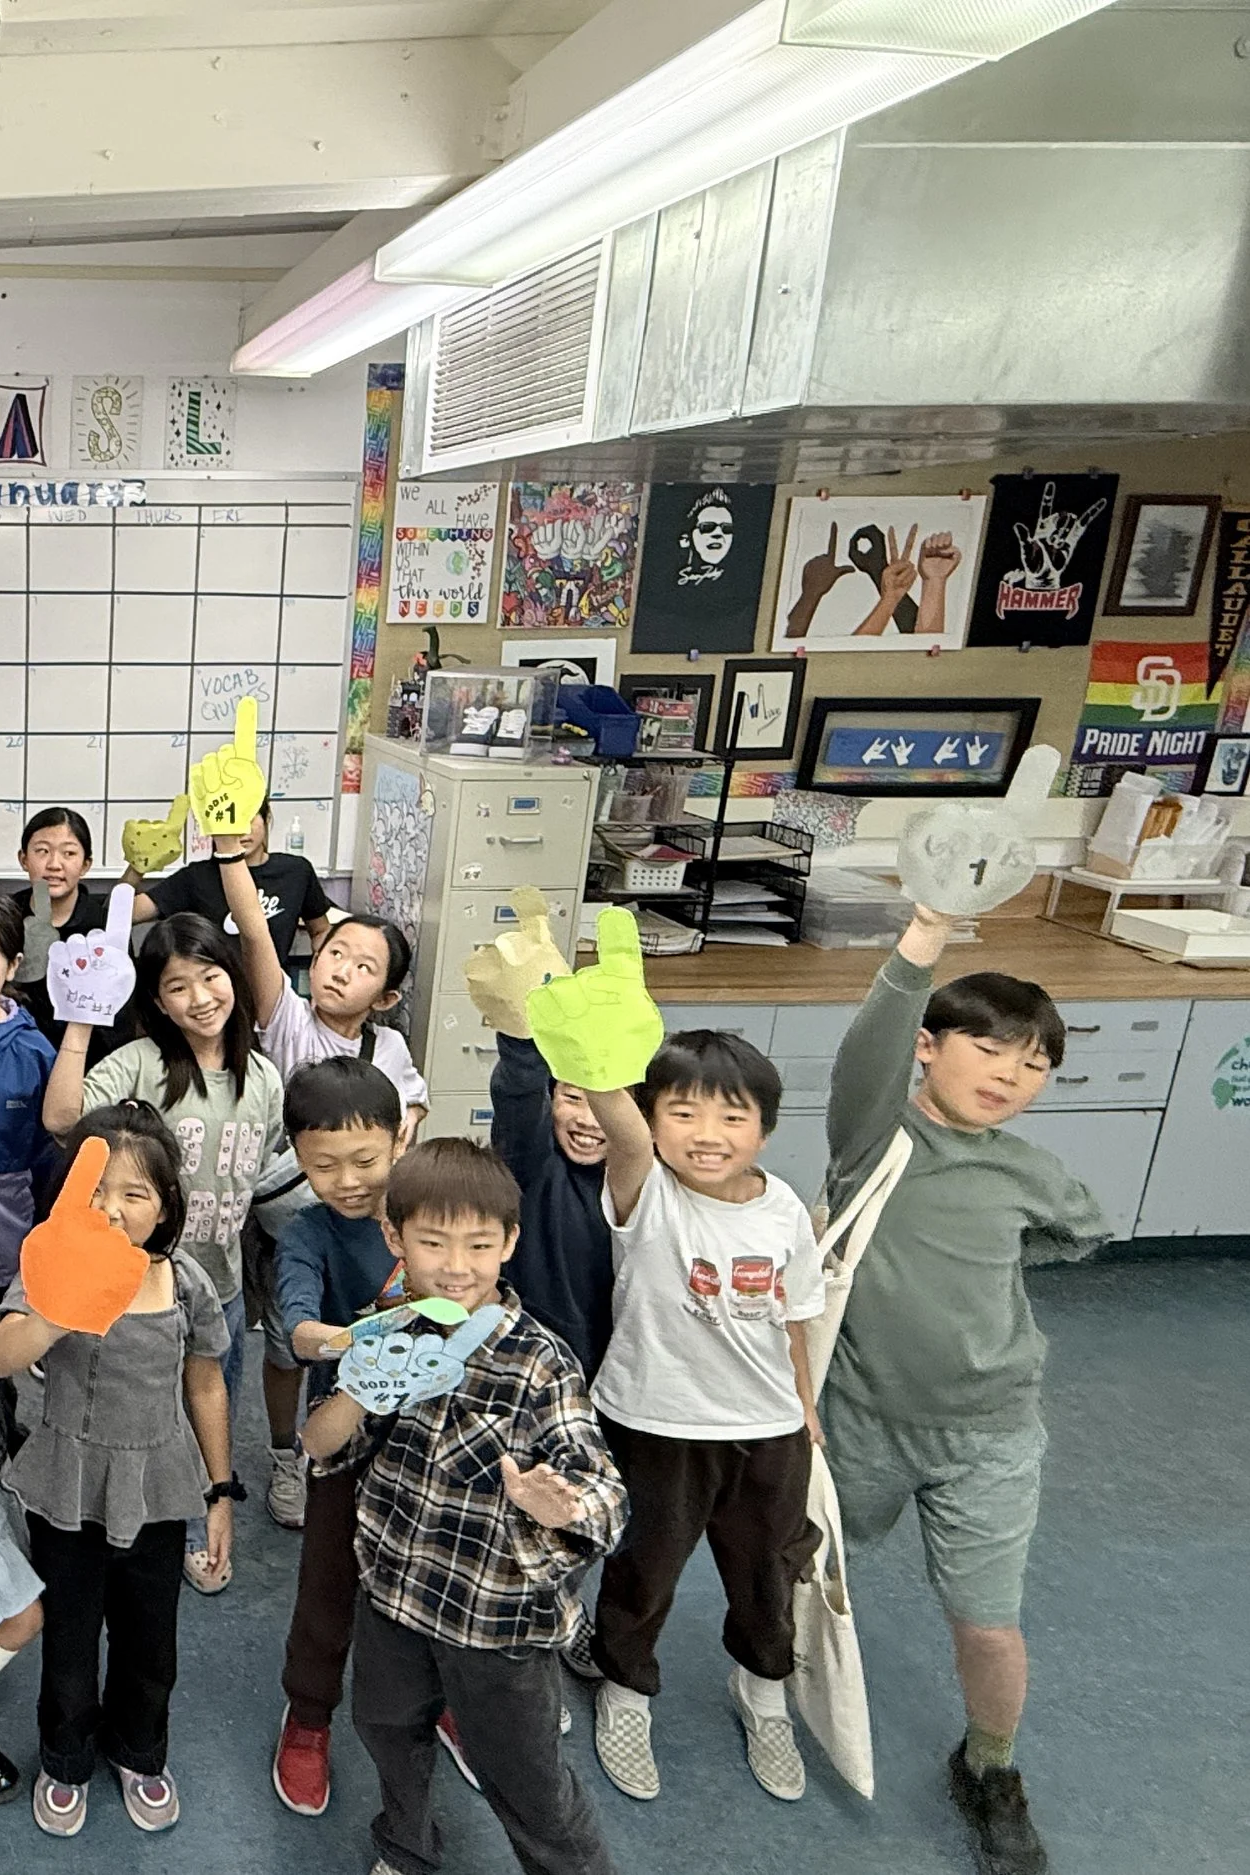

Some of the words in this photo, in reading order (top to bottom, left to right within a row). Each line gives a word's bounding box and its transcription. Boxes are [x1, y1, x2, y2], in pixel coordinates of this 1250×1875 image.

[186, 391, 222, 455] L
[425, 500, 447, 515] ALL
[134, 509, 183, 522] THURS
[397, 528, 492, 539] SOMETHING
[396, 542, 430, 556] WITHIN
[395, 556, 411, 571] US
[397, 568, 425, 582] THAT
[393, 580, 432, 600] this
[439, 582, 487, 600] world
[399, 601, 480, 615] NEEDS
[995, 581, 1083, 621] HAMMER
[200, 668, 259, 697] VOCAB
[5, 736, 23, 749] 20
[86, 735, 103, 749] 21
[170, 735, 185, 748] 22
[256, 735, 270, 747] 23
[1081, 728, 1143, 756] PRIDE
[215, 802, 236, 825] #1
[969, 858, 988, 886] 1
[359, 1380, 389, 1390] GOD
[394, 1380, 407, 1389] IS
